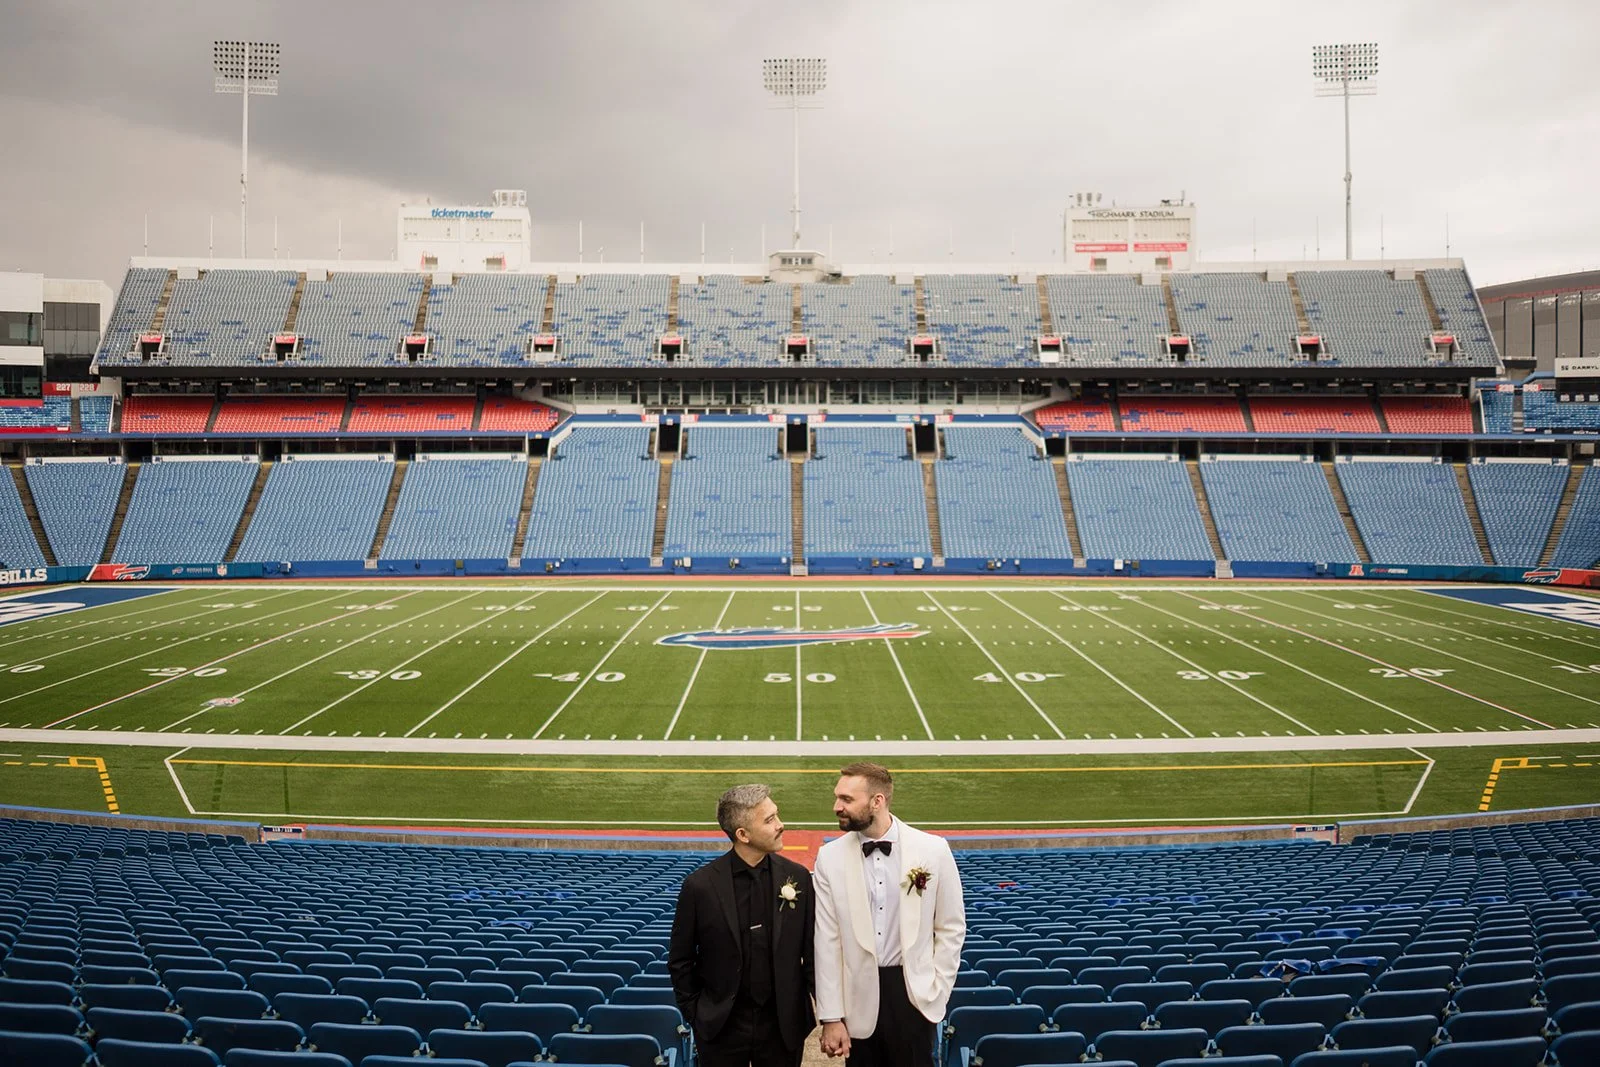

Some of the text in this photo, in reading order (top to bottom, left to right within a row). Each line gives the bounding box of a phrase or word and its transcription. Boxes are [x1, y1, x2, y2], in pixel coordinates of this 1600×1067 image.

[431, 208, 494, 218] ticketmaster
[1089, 209, 1174, 218] HIGHMARK STADIUM
[56, 383, 71, 391] 227
[79, 383, 94, 391] 228
[0, 568, 48, 584] BILLS
[148, 667, 227, 677] 20
[348, 669, 422, 680] 30
[551, 671, 626, 682] 40
[973, 671, 1047, 682] 40
[1176, 670, 1250, 680] 30
[1368, 667, 1444, 678] 20
[763, 672, 837, 683] 50
